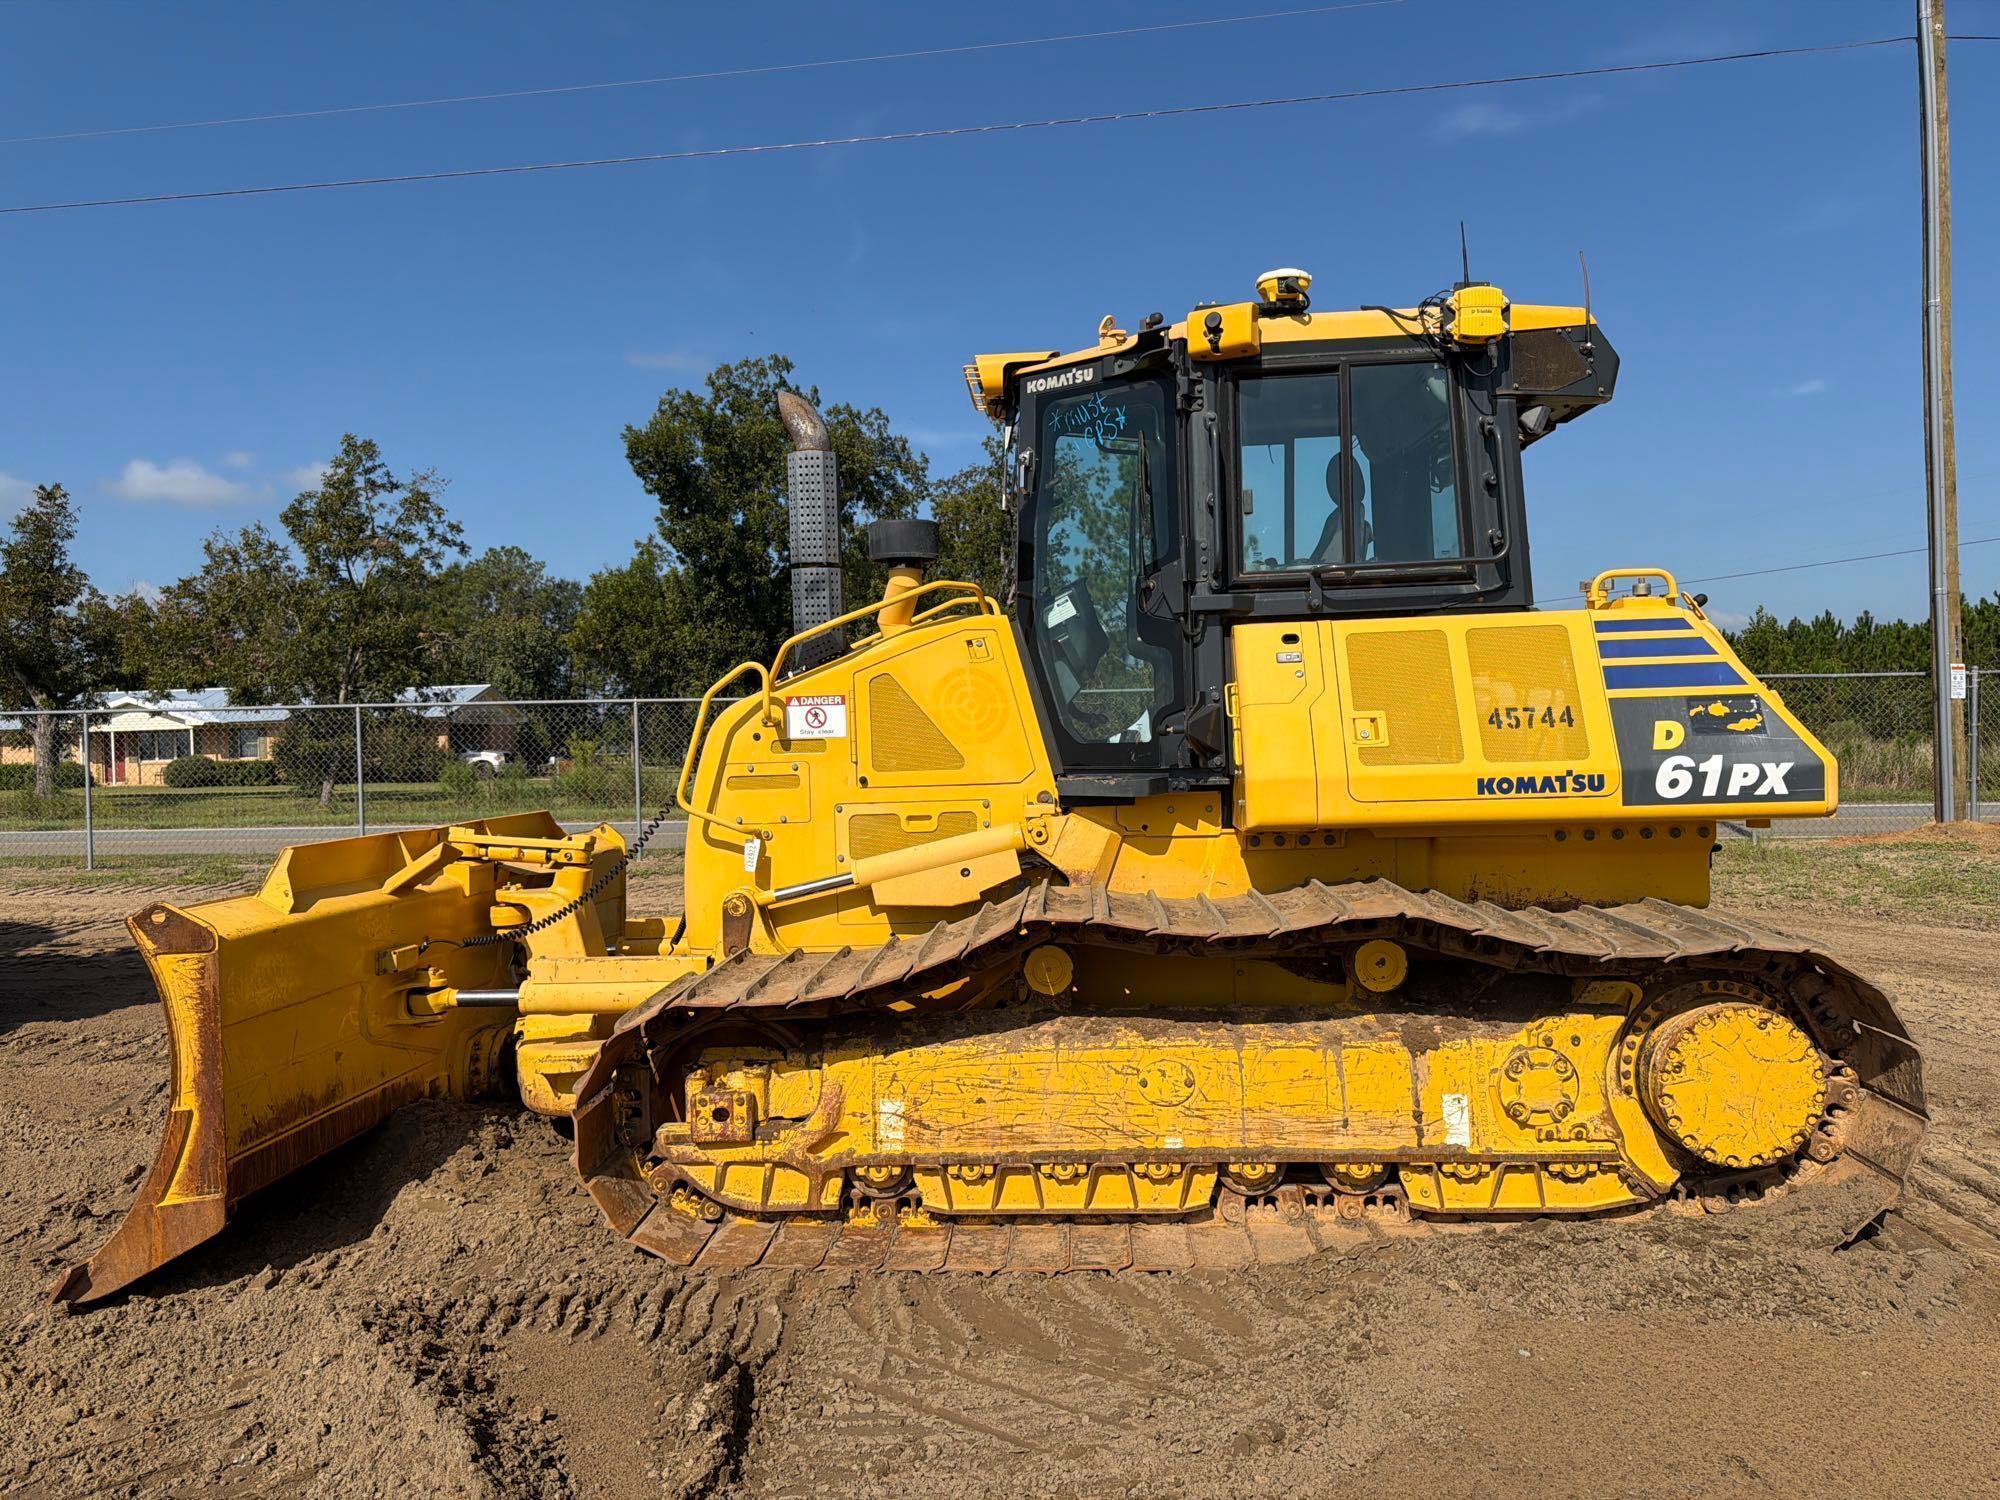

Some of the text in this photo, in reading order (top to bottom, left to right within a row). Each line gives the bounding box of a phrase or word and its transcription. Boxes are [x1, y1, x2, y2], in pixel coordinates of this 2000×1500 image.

[1026, 368, 1094, 394] KOMATSU
[800, 696, 842, 705] DANGER
[1488, 705, 1575, 730] 45744
[1652, 720, 1686, 750] D
[1477, 769, 1605, 795] KOMATSU
